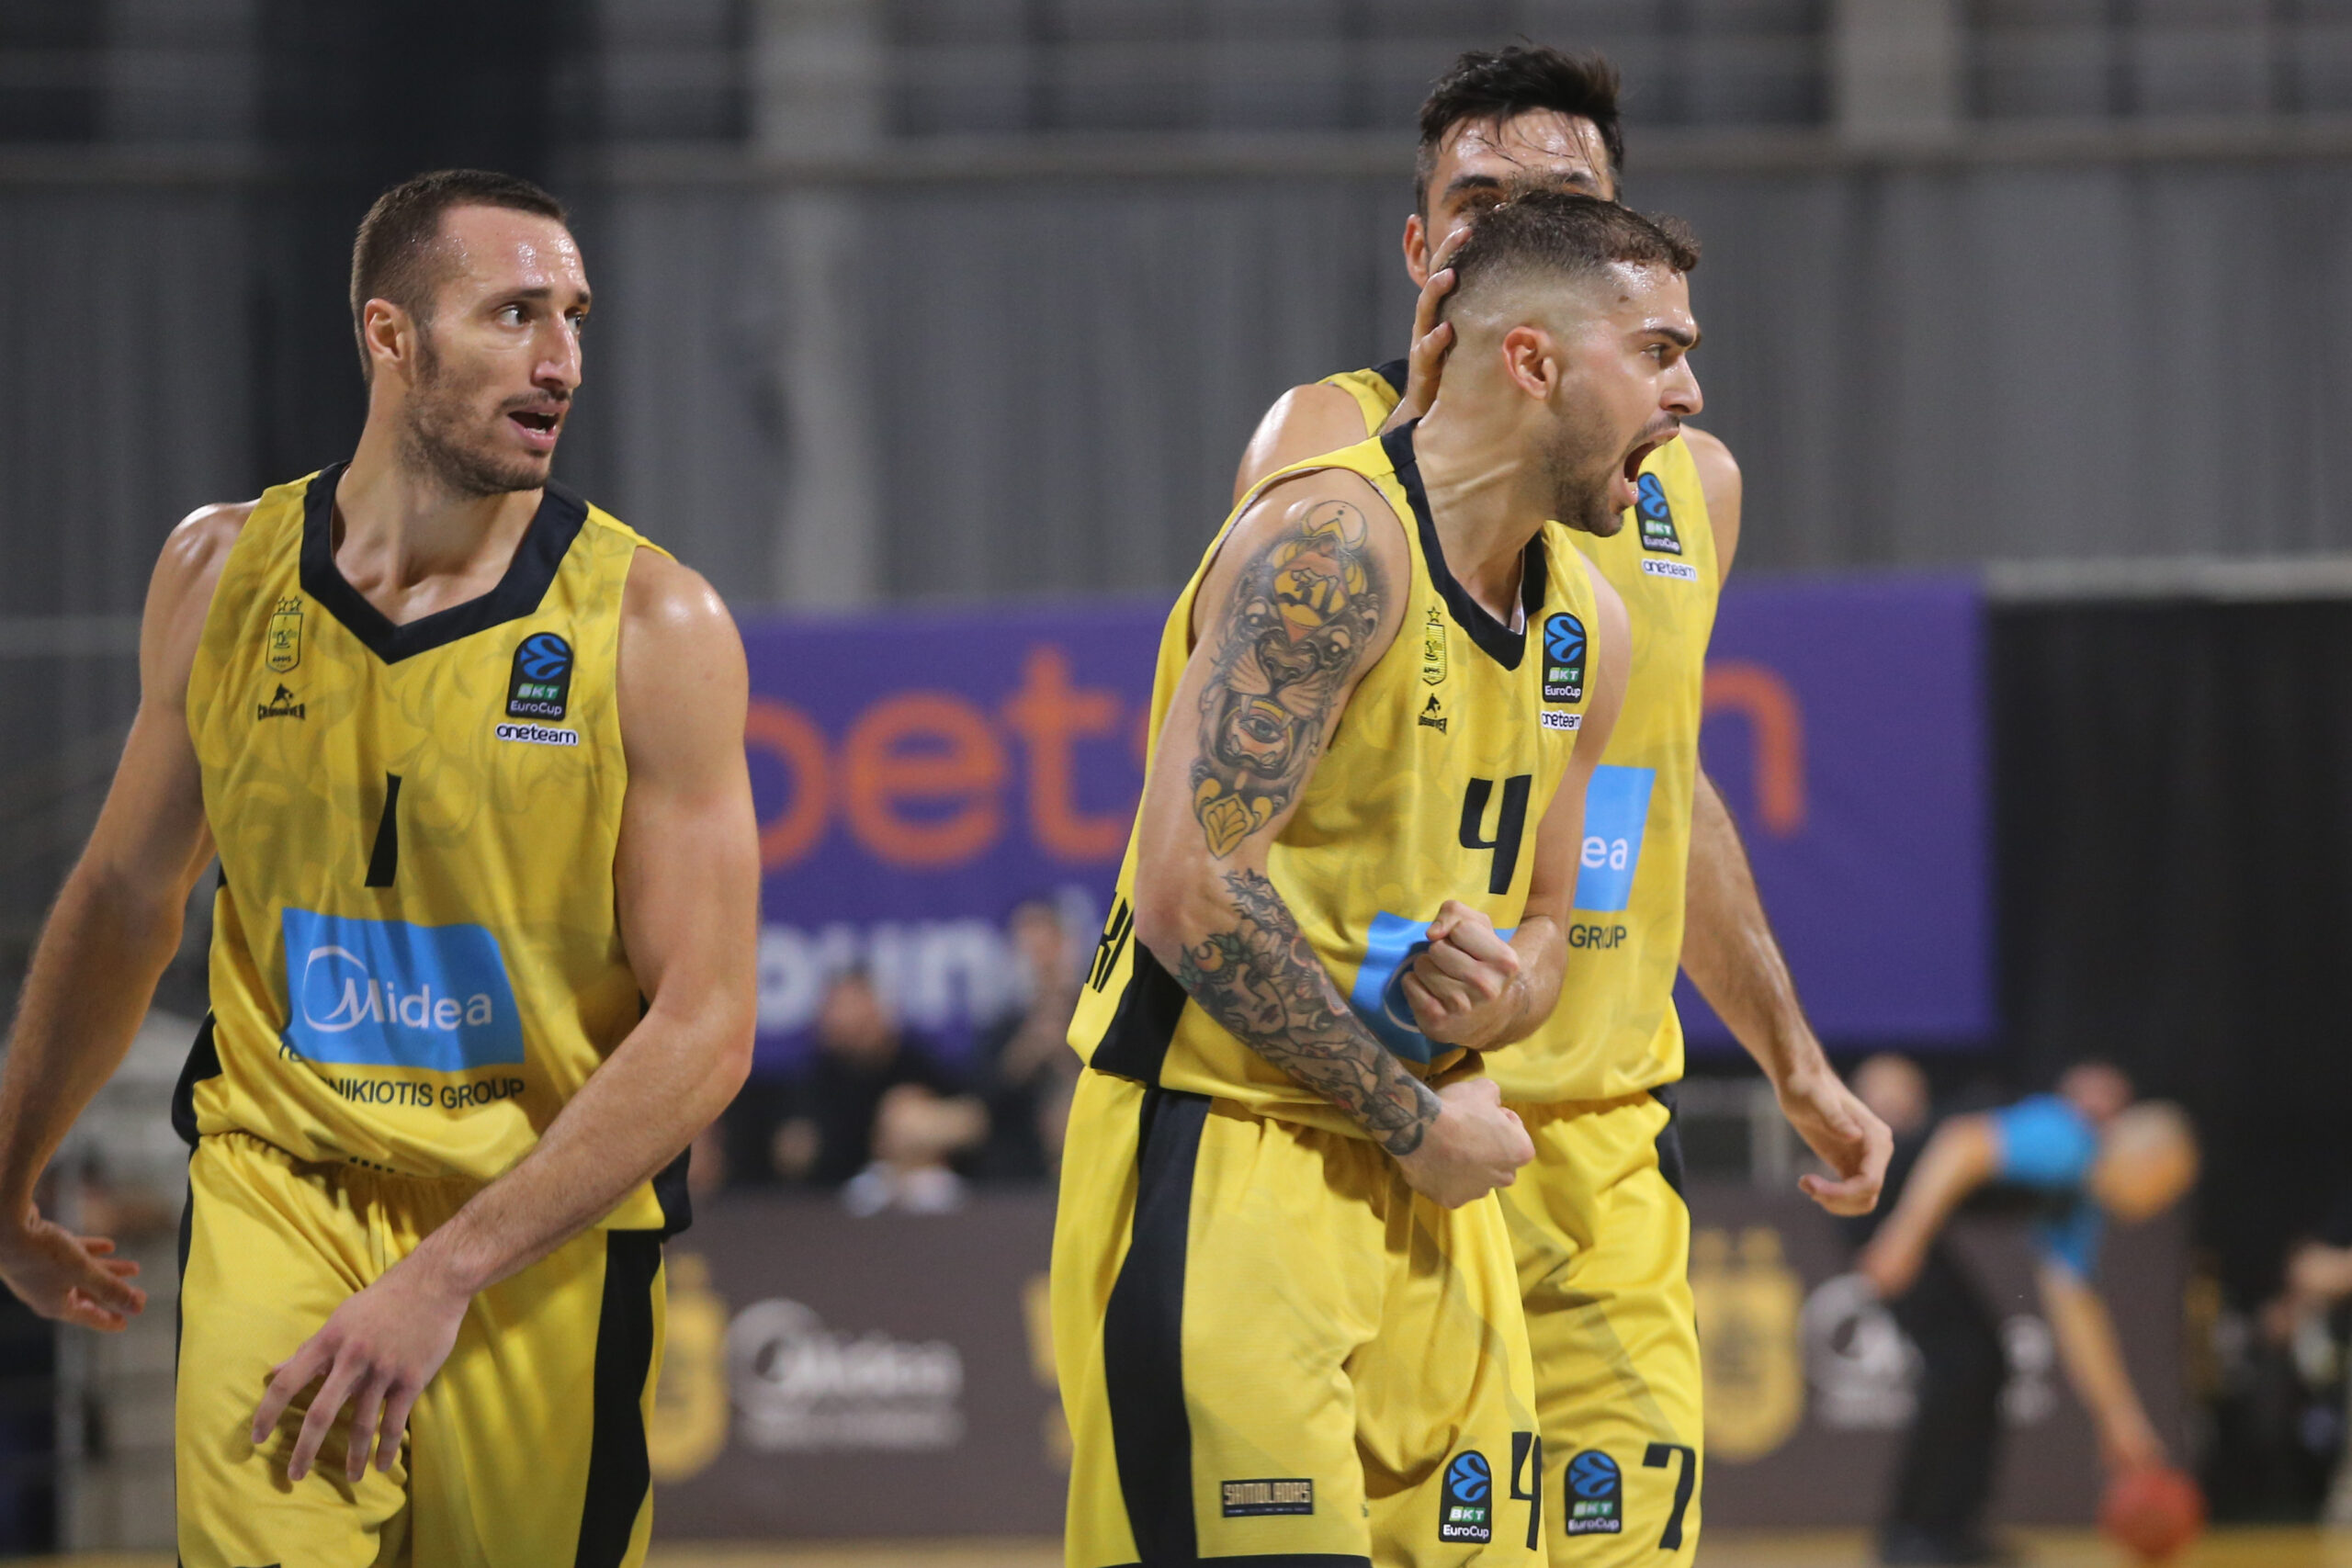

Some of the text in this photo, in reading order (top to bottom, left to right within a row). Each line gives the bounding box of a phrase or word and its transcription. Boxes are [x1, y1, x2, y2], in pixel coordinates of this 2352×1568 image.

[1643, 559, 1697, 581] oneteam
[1549, 670, 1578, 681] BKT
[518, 684, 559, 699] BKT
[1544, 685, 1581, 698] EuroCup
[510, 700, 562, 716] EuroCup
[496, 724, 577, 744] oneteam
[364, 770, 402, 887] 1
[1459, 774, 1532, 895] 4
[322, 974, 493, 1032] Midea
[440, 1077, 525, 1109] GROUP
[1510, 1431, 1543, 1551] 4
[1642, 1442, 1696, 1551] 7
[1451, 1508, 1485, 1520] BKT
[1567, 1517, 1620, 1531] EuroCup
[1443, 1524, 1489, 1539] EuroCup
